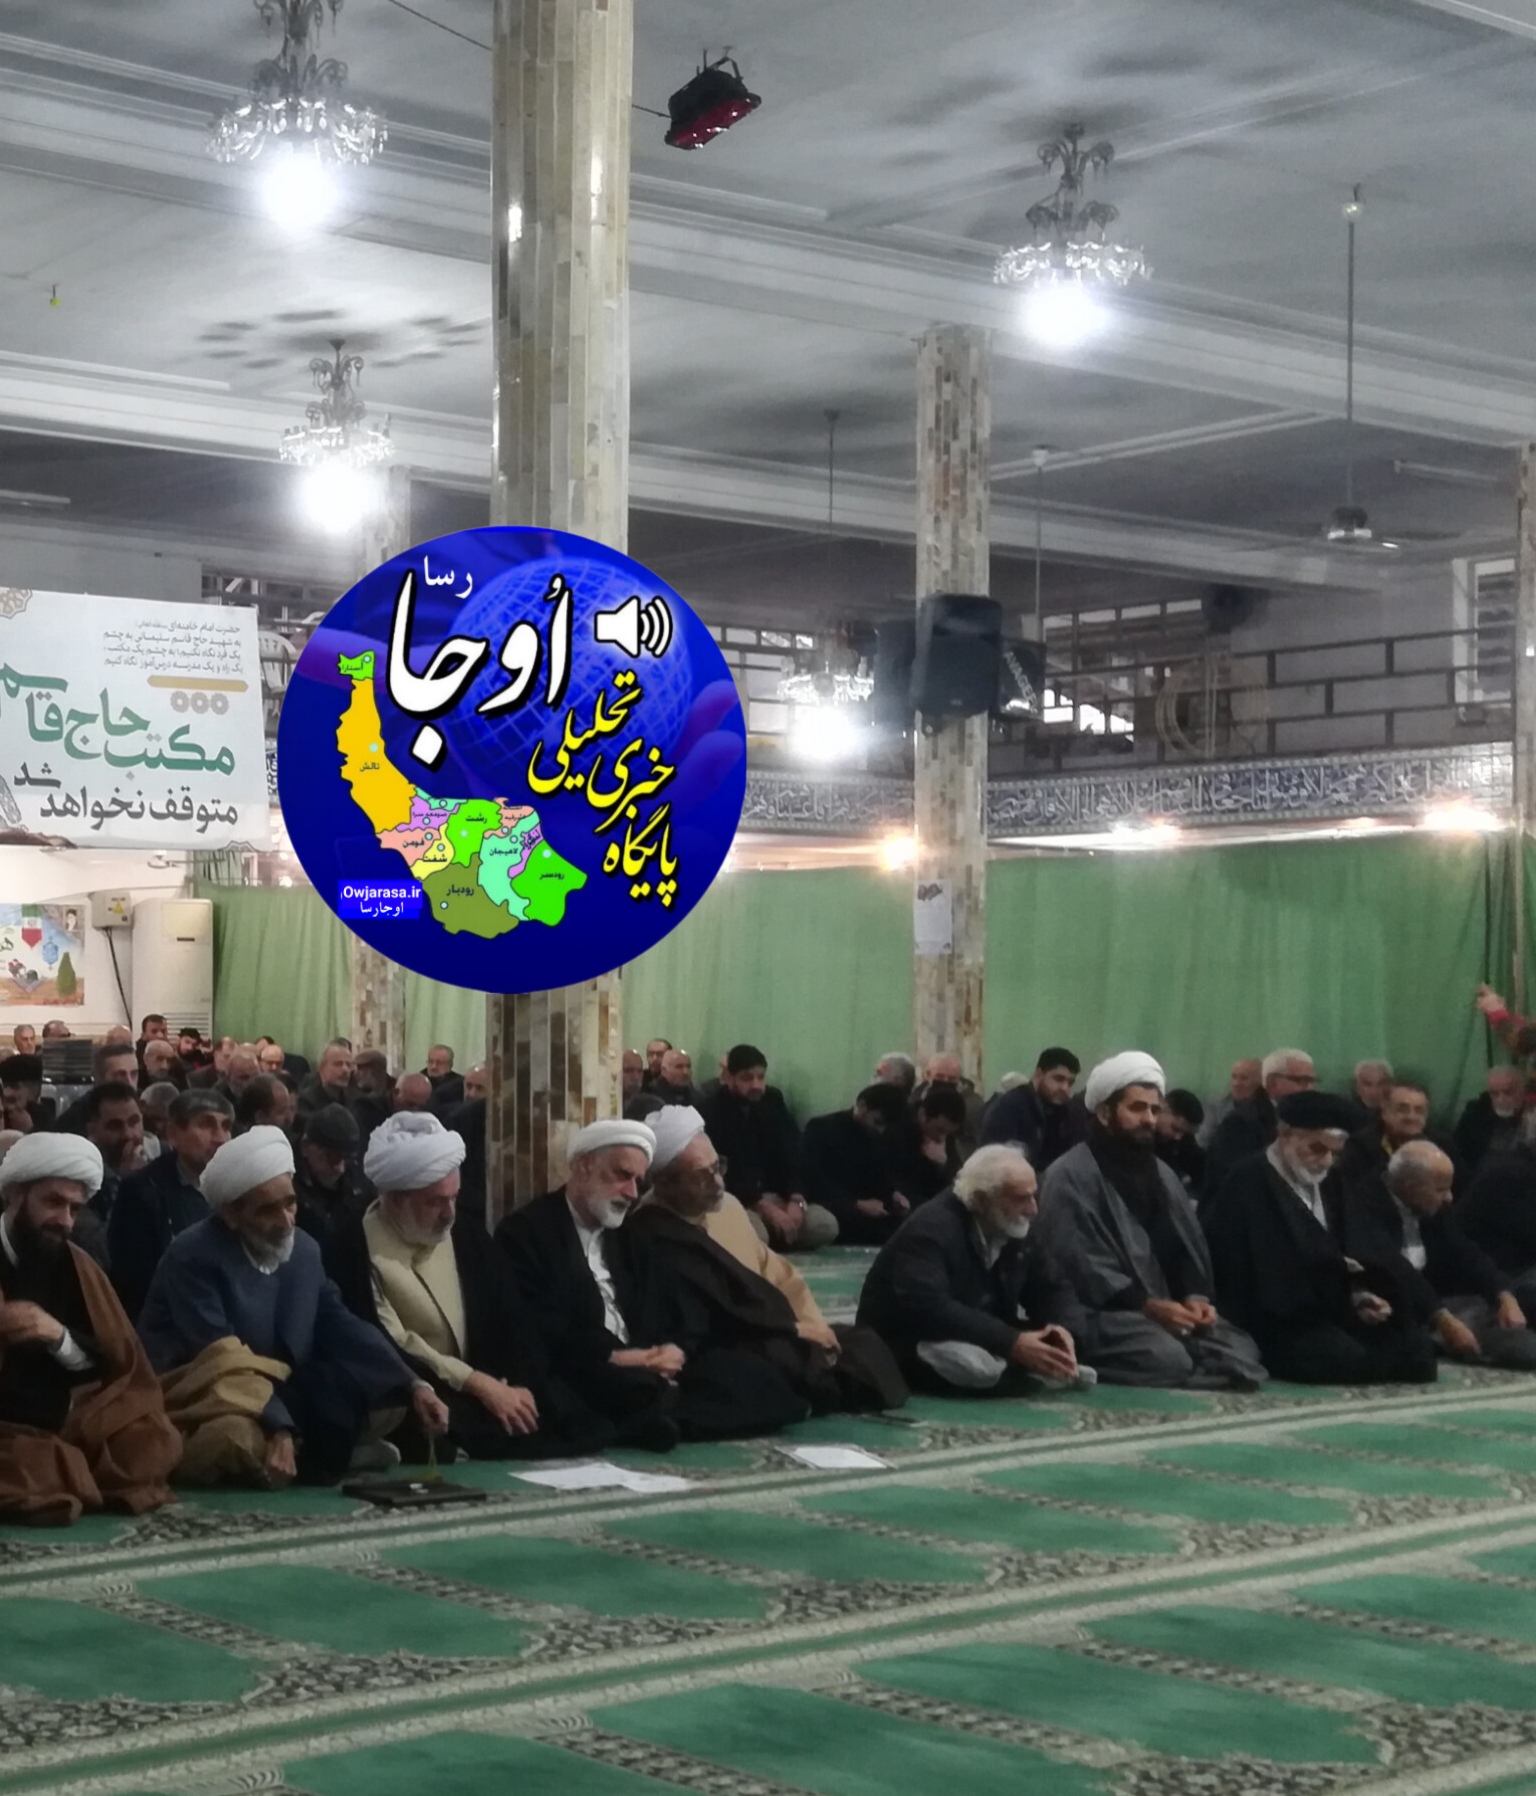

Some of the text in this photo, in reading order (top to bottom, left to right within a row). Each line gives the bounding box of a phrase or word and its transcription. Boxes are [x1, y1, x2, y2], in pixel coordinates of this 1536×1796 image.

[200, 622, 214, 633] امام
[216, 625, 240, 636] حضرت
[135, 631, 169, 643] سلیمانی
[171, 632, 191, 646] قاسم
[193, 635, 208, 648] حاج
[209, 637, 232, 648] شهید
[64, 688, 151, 760] حاج
[104, 725, 235, 781] مکتب
[14, 762, 238, 834] متوقف نخواهد شد
